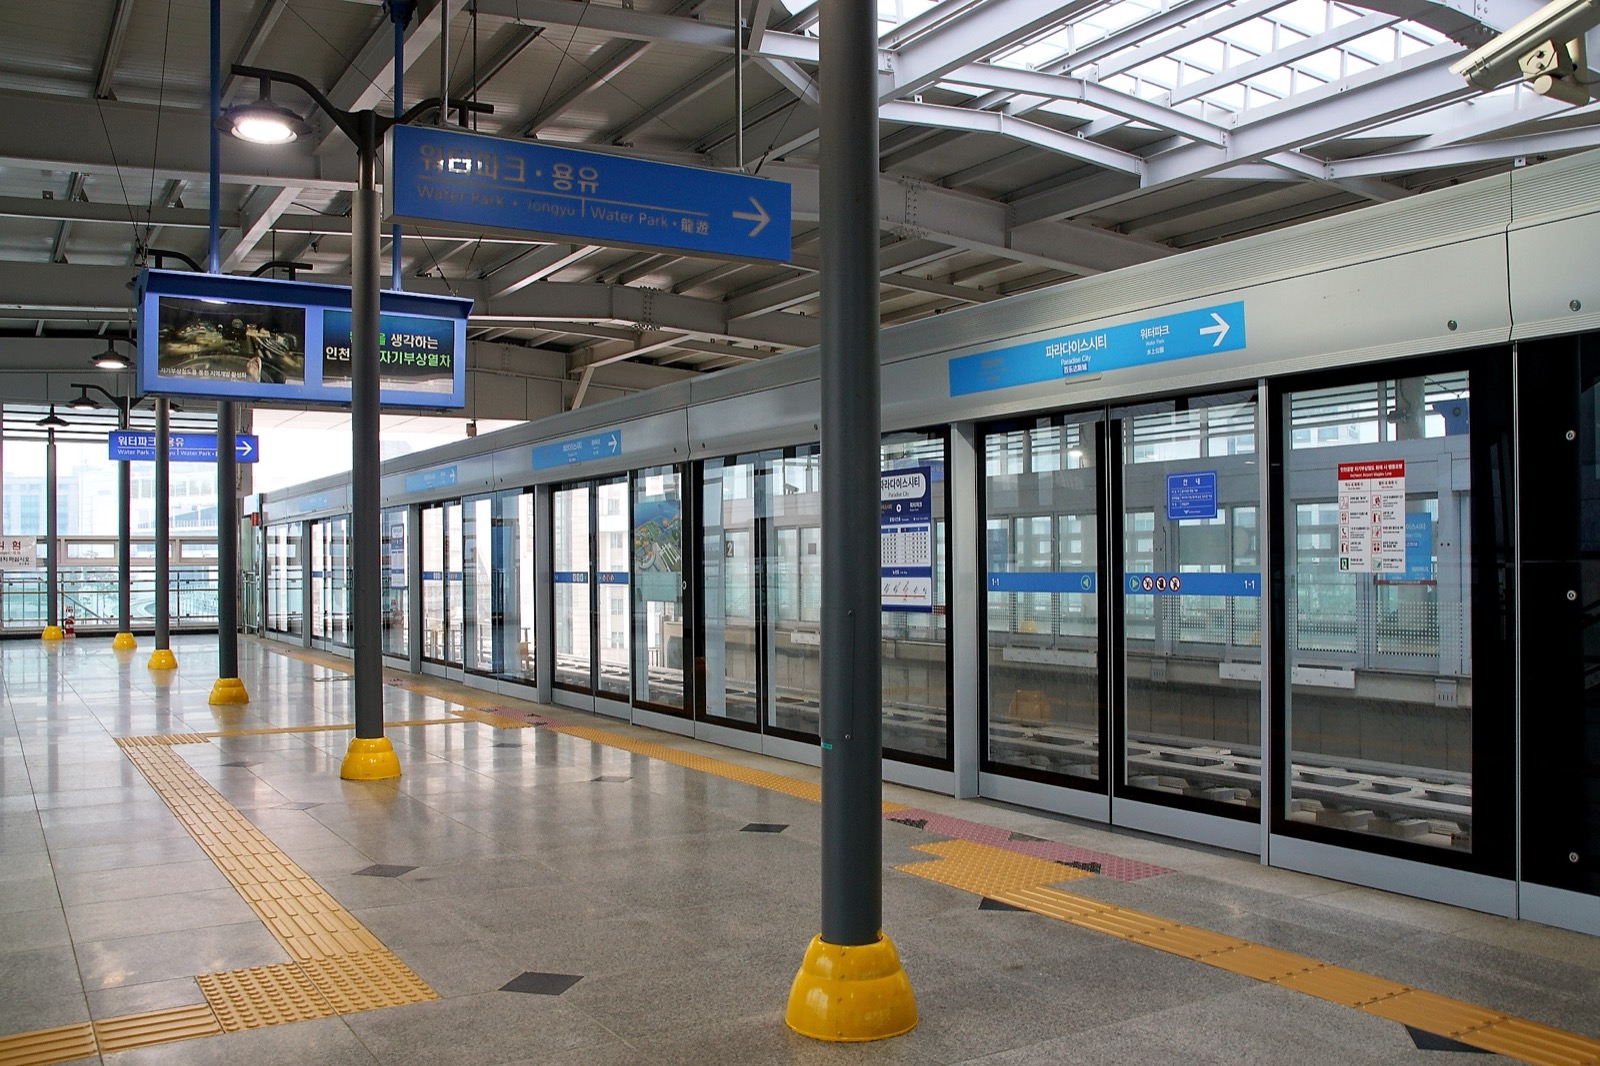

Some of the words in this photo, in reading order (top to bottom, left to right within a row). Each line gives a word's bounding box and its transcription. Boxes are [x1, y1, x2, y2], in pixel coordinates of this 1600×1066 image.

[551, 162, 599, 194] 용유
[416, 184, 464, 201] Water
[471, 189, 504, 208] Park
[590, 205, 634, 224] Water
[638, 211, 668, 228] Park
[1140, 324, 1170, 340] 워터파크
[390, 333, 439, 350] 생각하는
[1045, 333, 1108, 359] 파라다이스시티
[325, 346, 351, 361] 인천
[380, 350, 451, 368] 자기부상열차
[1060, 355, 1081, 366] Paradise
[1081, 353, 1092, 363] City
[117, 435, 156, 447] 워터파크
[117, 448, 136, 456] Water
[1244, 579, 1255, 590] 1-1
